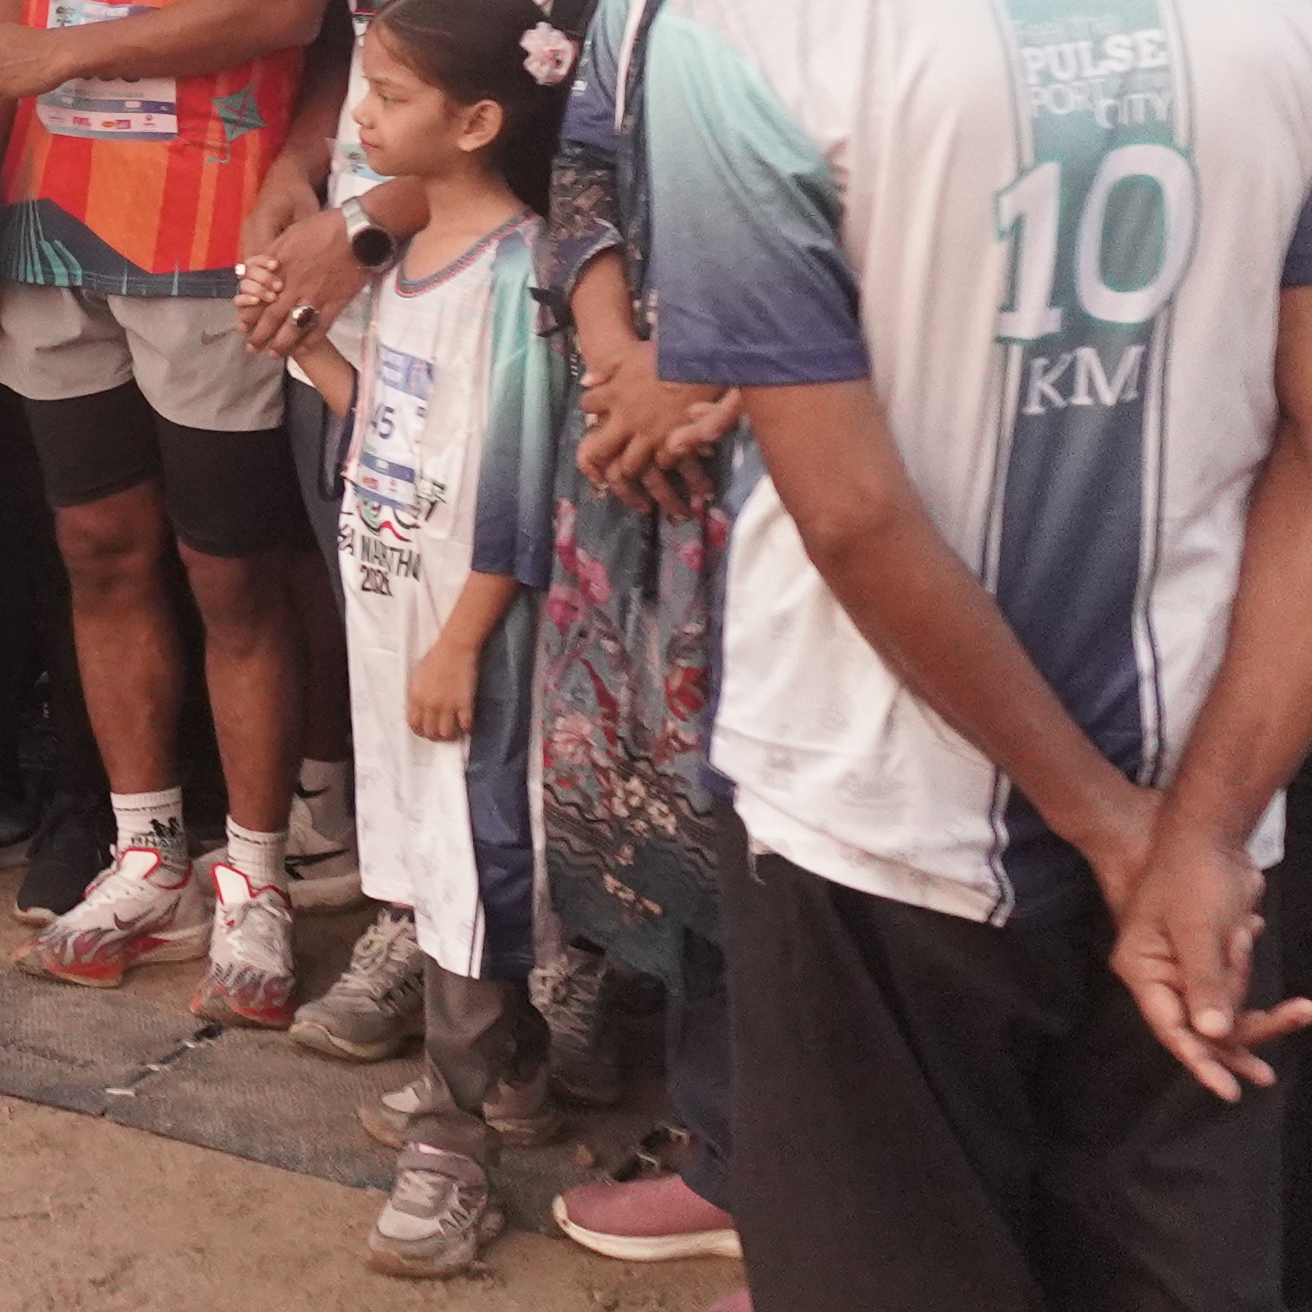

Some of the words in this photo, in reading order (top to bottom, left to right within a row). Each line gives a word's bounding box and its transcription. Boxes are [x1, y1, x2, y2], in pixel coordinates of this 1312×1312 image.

[1020, 28, 1170, 84] PULSE
[996, 142, 1198, 340] 10
[1022, 344, 1146, 415] KM
